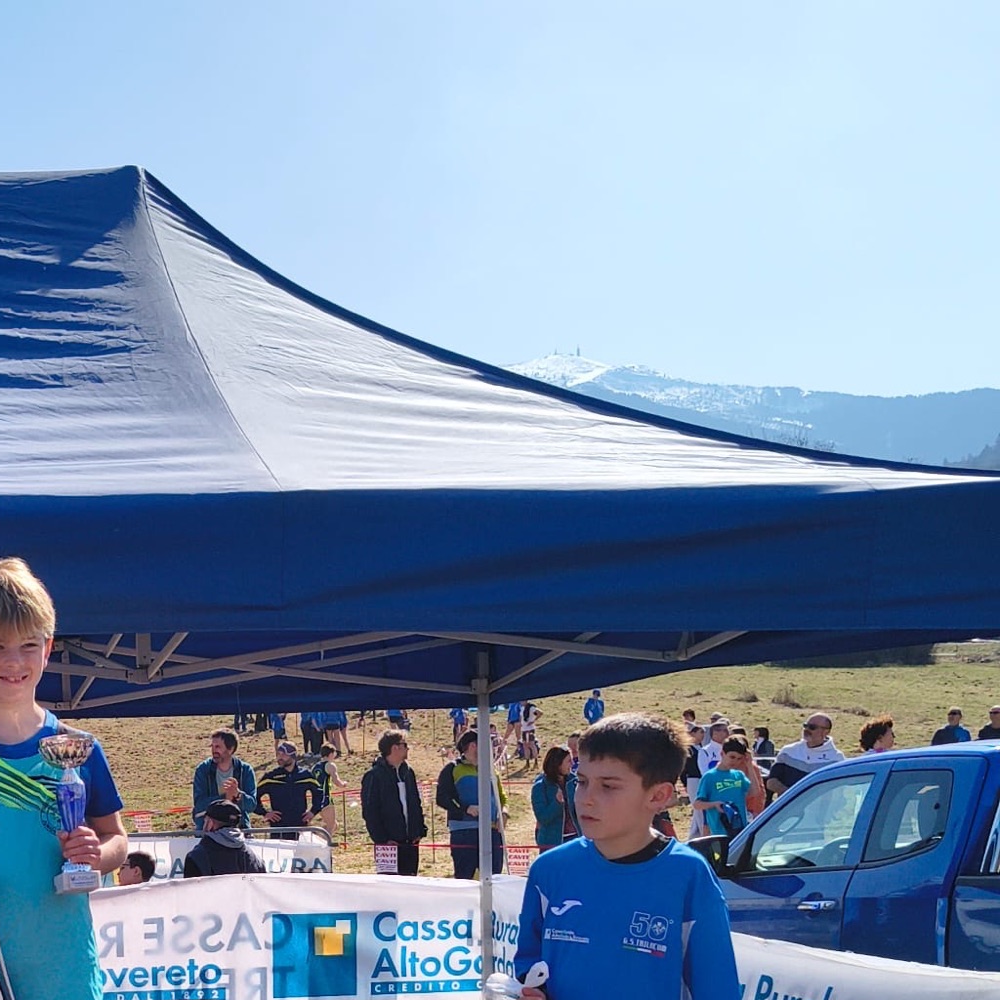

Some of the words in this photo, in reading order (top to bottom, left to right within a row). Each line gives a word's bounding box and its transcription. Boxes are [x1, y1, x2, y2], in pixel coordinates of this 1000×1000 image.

[372, 911, 473, 942] Cassa
[374, 981, 461, 993] CREDITO
[170, 990, 220, 1000] 1892
